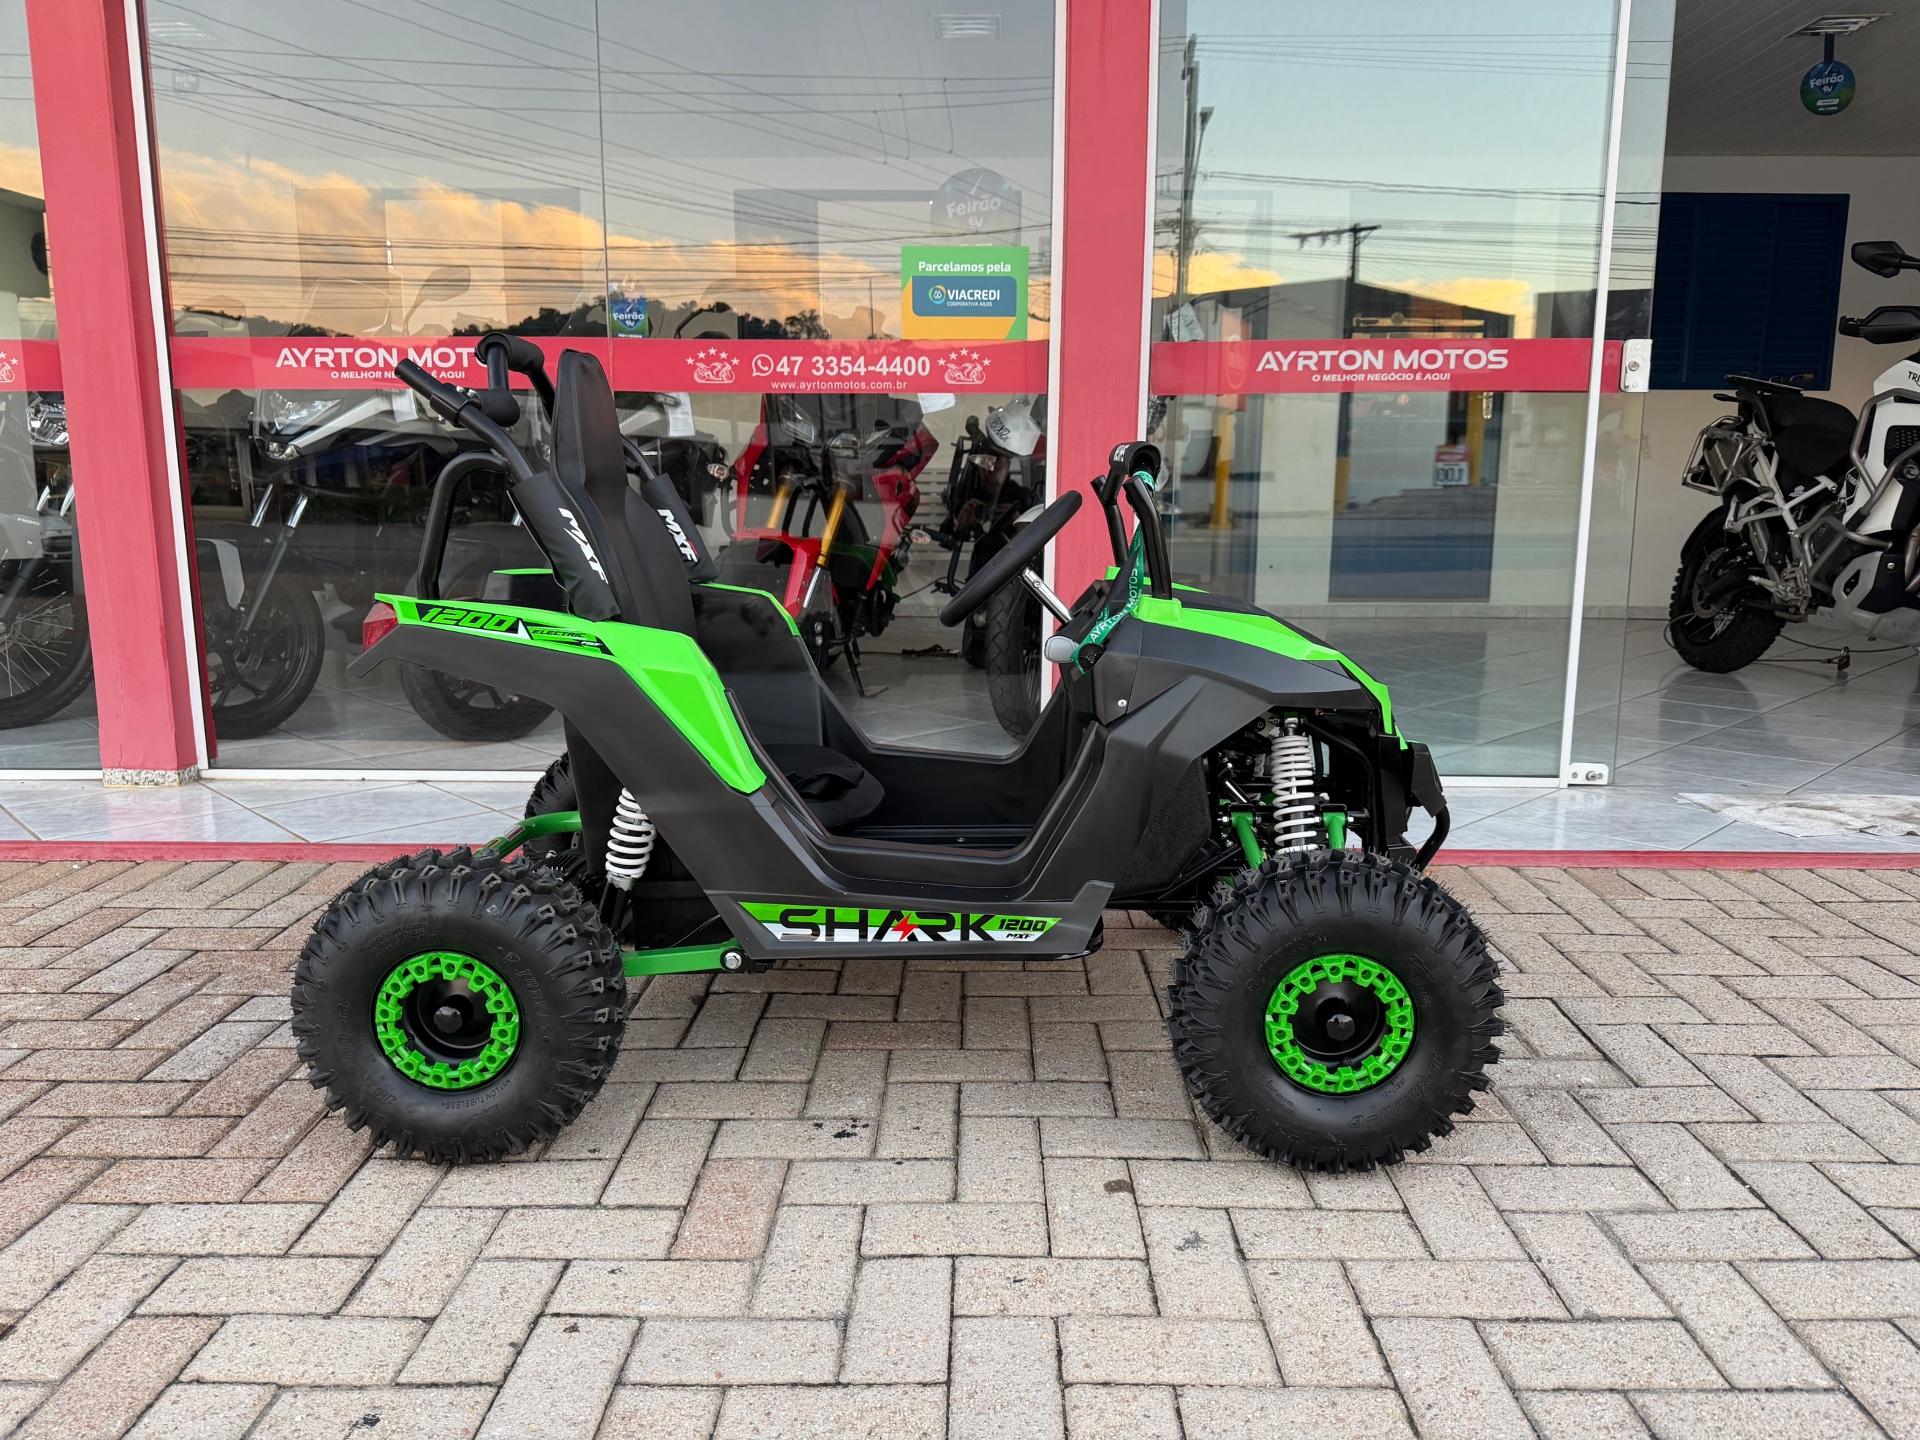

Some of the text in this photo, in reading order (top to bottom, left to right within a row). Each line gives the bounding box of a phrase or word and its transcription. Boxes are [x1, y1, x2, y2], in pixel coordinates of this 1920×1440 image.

[1809, 73, 1844, 88] Feirão
[945, 193, 1002, 219] Feirão
[918, 260, 1012, 274] Parcelamos pela
[947, 289, 1000, 301] VIACREDI
[613, 311, 645, 320] Feirão
[275, 347, 488, 368] AYRTON MOT
[1256, 348, 1509, 371] AYRTON MOTOS
[776, 355, 931, 377] 47 3354-4400
[331, 370, 339, 379] O
[340, 370, 383, 379] MELHOR
[439, 370, 465, 379] AQUI
[1311, 371, 1451, 382] O MELHOR NEGÓCIO É AQUI
[770, 380, 908, 391] www.ayrtonmotos.com.br
[657, 508, 699, 563] MXF
[1089, 608, 1128, 643] AYRTON
[1126, 568, 1138, 608] MOTOS
[420, 607, 518, 632] 1200
[531, 629, 587, 639] ELECTRIC
[778, 908, 998, 942] SHARK
[998, 918, 1048, 932] 1200
[445, 1095, 485, 1110] TUBELESS
